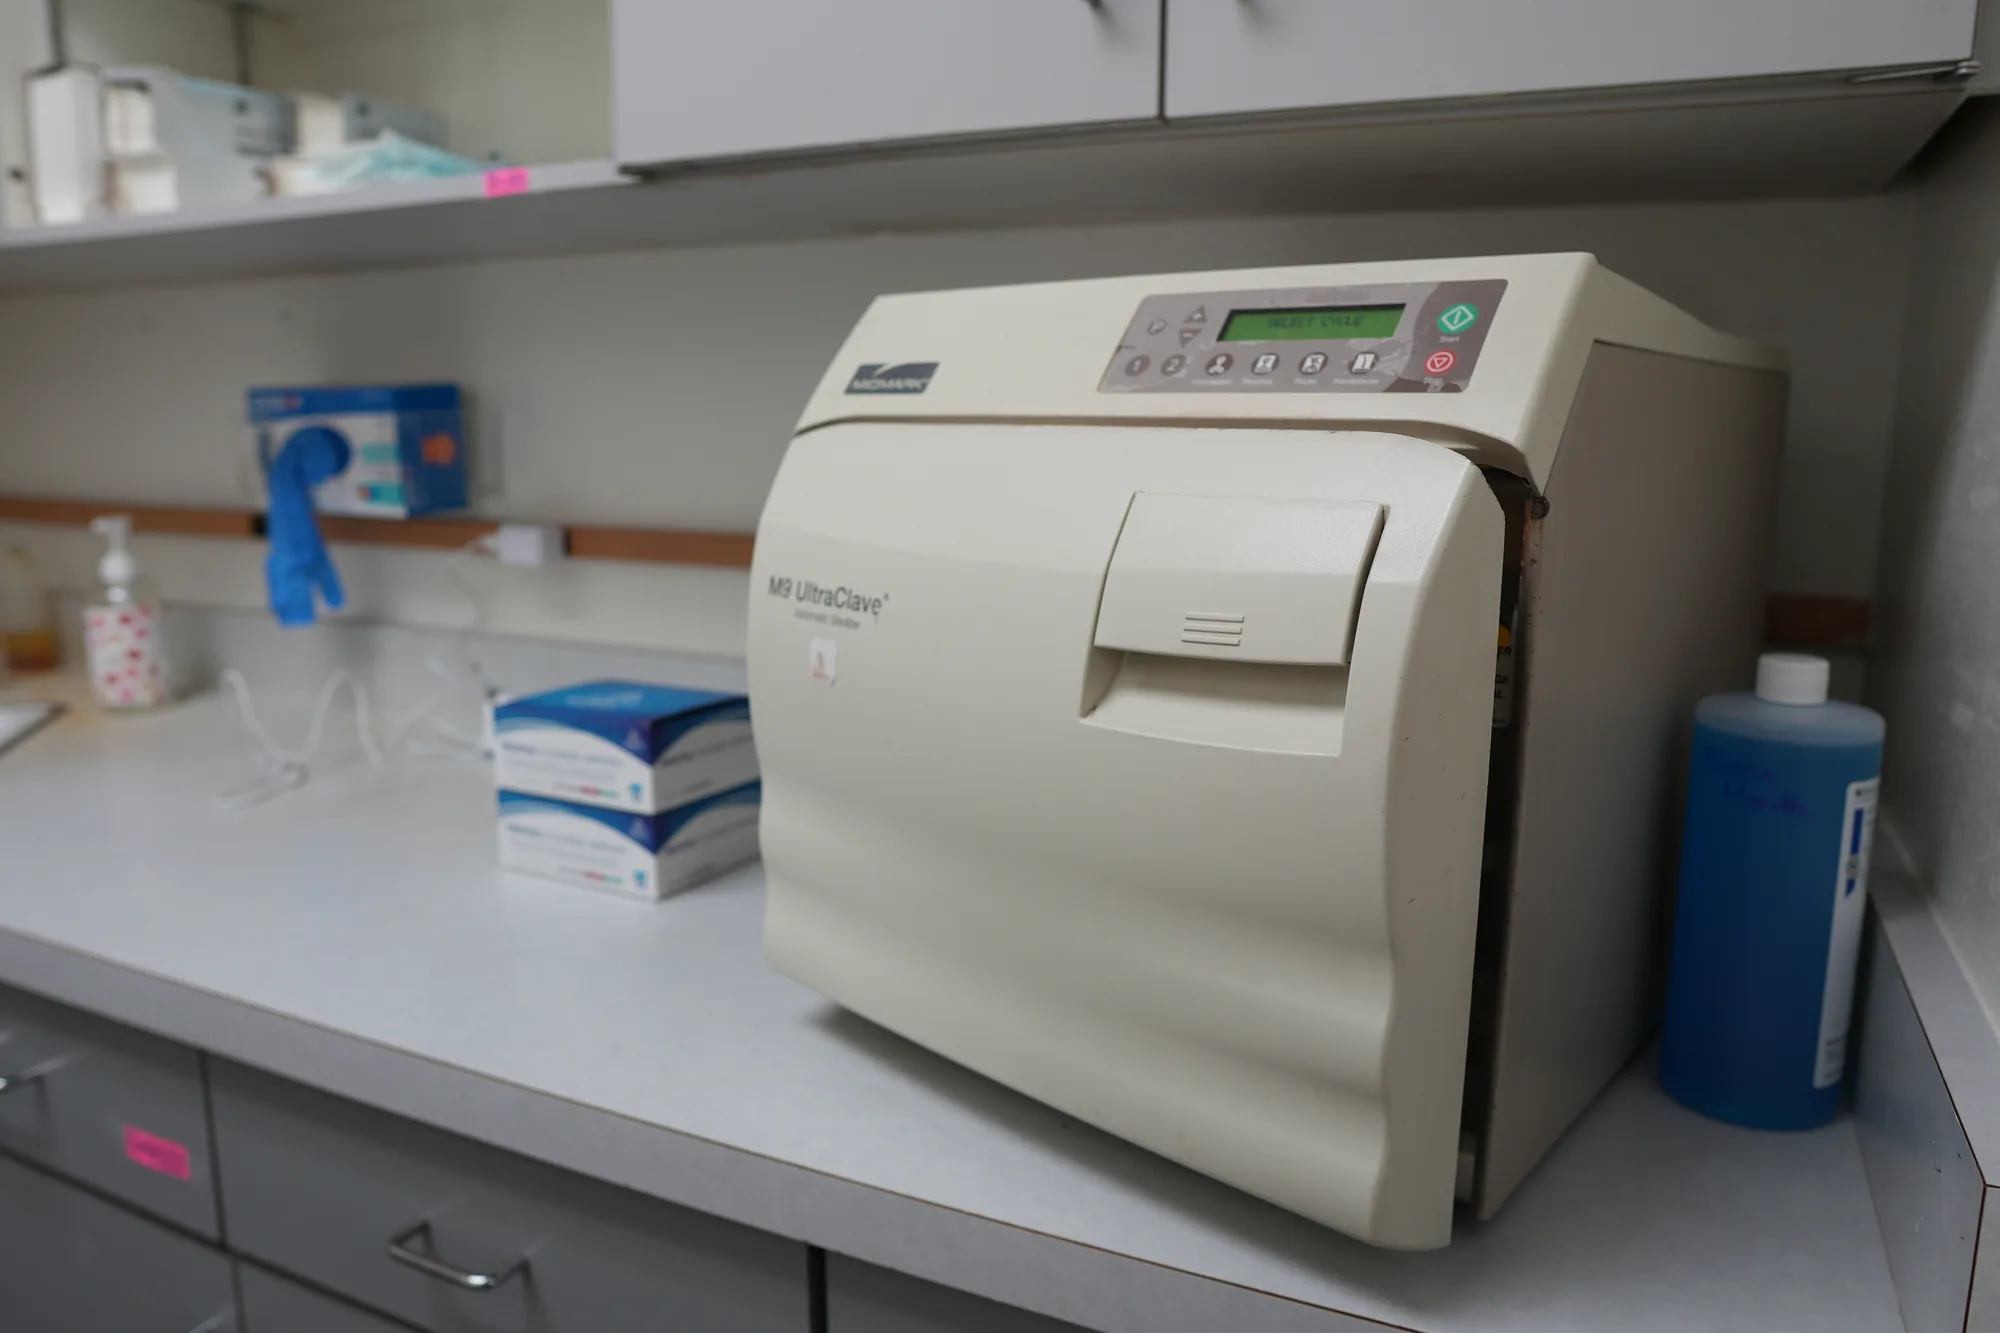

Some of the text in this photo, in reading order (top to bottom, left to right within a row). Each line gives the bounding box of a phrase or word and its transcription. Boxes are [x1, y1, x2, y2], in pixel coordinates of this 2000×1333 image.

[1268, 314, 1365, 329] SELECT CYCLE
[852, 377, 930, 391] MIDMARK
[768, 575, 883, 616] M9 UltraClave
